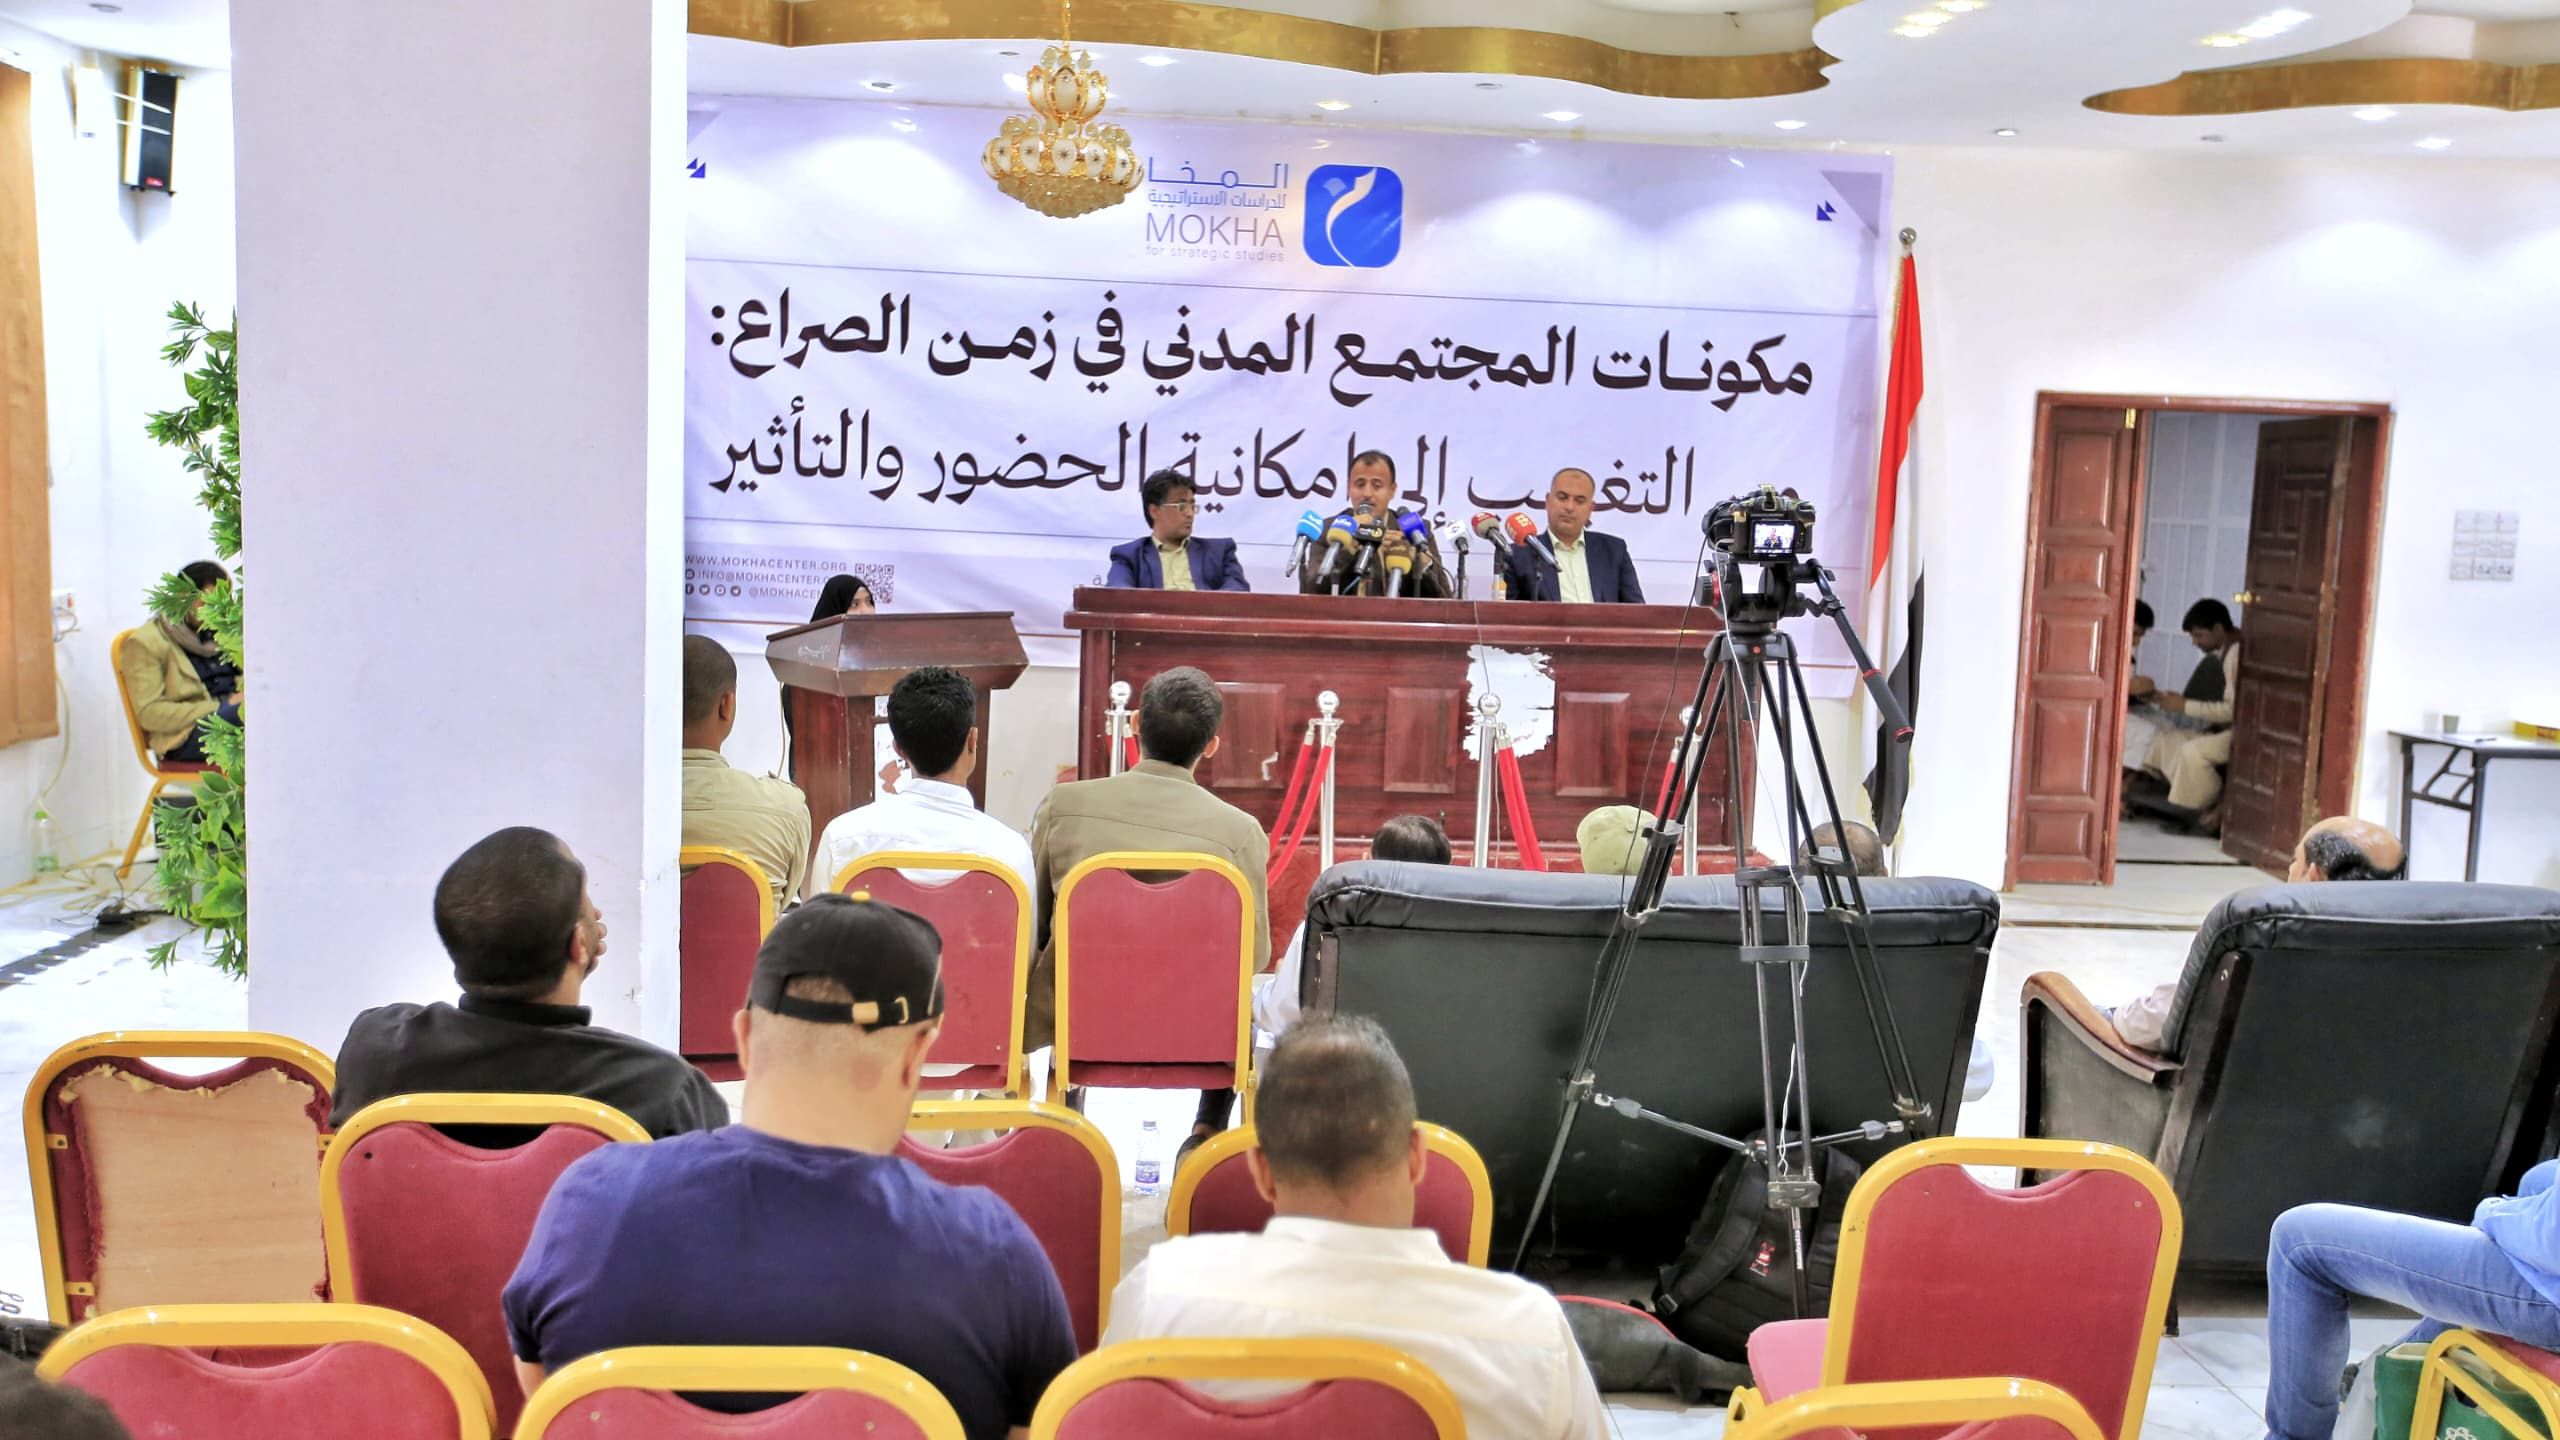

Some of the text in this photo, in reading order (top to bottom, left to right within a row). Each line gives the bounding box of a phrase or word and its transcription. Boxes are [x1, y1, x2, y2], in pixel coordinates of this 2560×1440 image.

[1146, 212, 1285, 249] MOKHA
[1231, 191, 1288, 212] للدراسات
[1146, 246, 1285, 262] for strategic studies
[711, 286, 1813, 412] مكونات المجتمع المدني في زمن الصراع:
[708, 395, 904, 502] والتأثير
[917, 421, 1148, 505] الحضور
